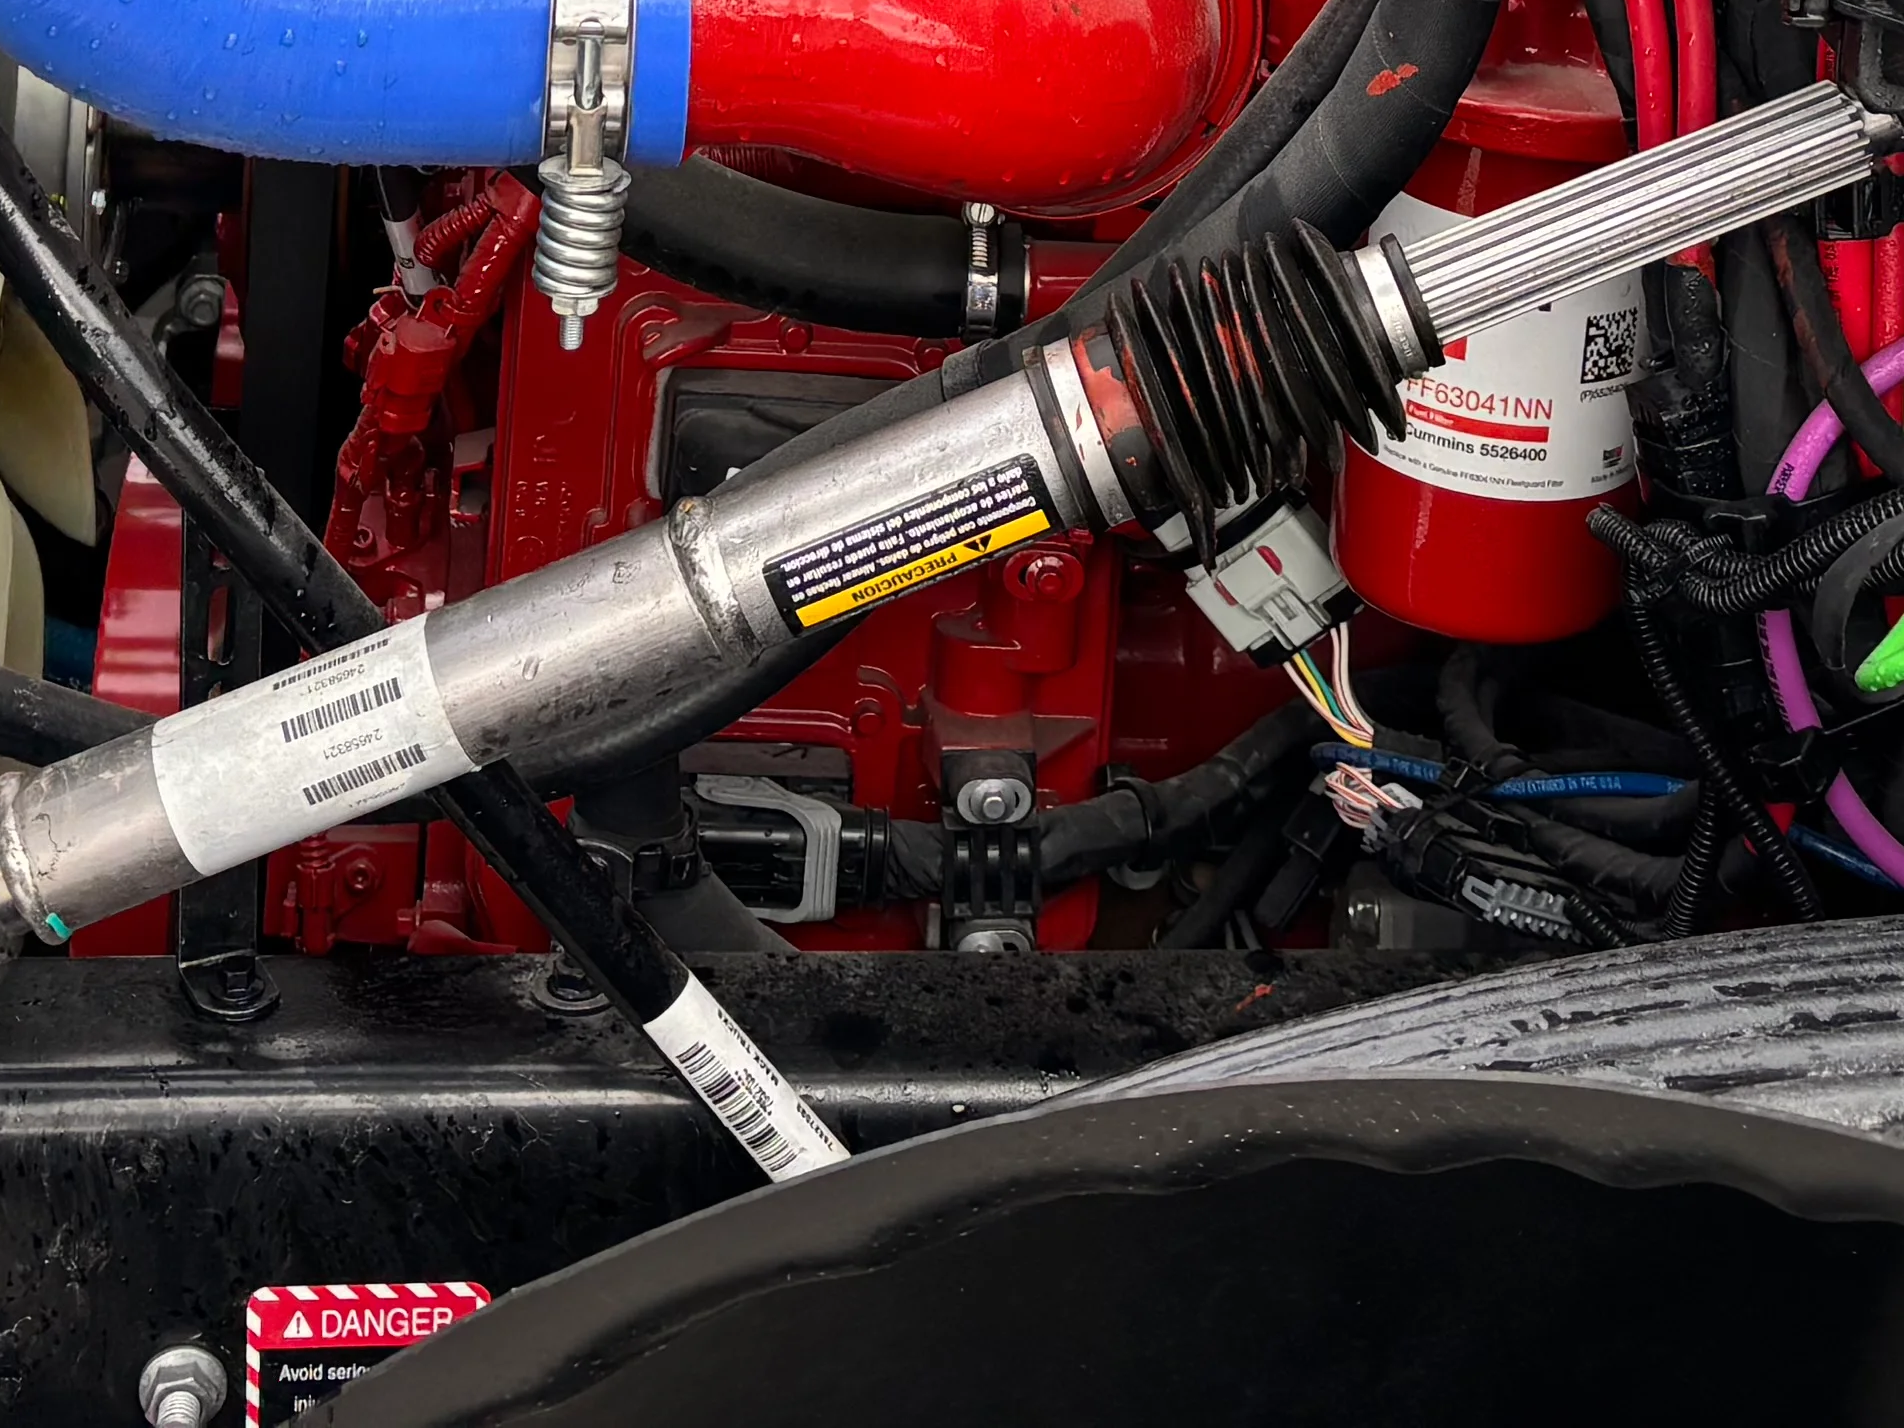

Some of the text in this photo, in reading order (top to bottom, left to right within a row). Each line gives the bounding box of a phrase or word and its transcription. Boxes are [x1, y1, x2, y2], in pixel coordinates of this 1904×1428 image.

[1406, 377, 1553, 420] FF63041NN
[1404, 422, 1548, 463] Cummins 5526400
[969, 480, 987, 495] los
[901, 484, 970, 523] componentes
[975, 494, 1036, 528] Componente
[785, 478, 1029, 587] partes de acoplamiento. Falla puede resultar en
[844, 521, 885, 547] sistema
[885, 514, 903, 530] del
[956, 519, 976, 535] con
[830, 539, 845, 553] de
[909, 542, 923, 555] de
[921, 525, 958, 549] peligro
[840, 561, 876, 583] Alinear
[850, 549, 957, 604] PRECAUCION
[791, 591, 805, 602] en
[321, 726, 383, 762] 24658321
[752, 1052, 780, 1086] MACK
[321, 1307, 454, 1338] DANGER
[278, 1363, 324, 1382] Avoid
